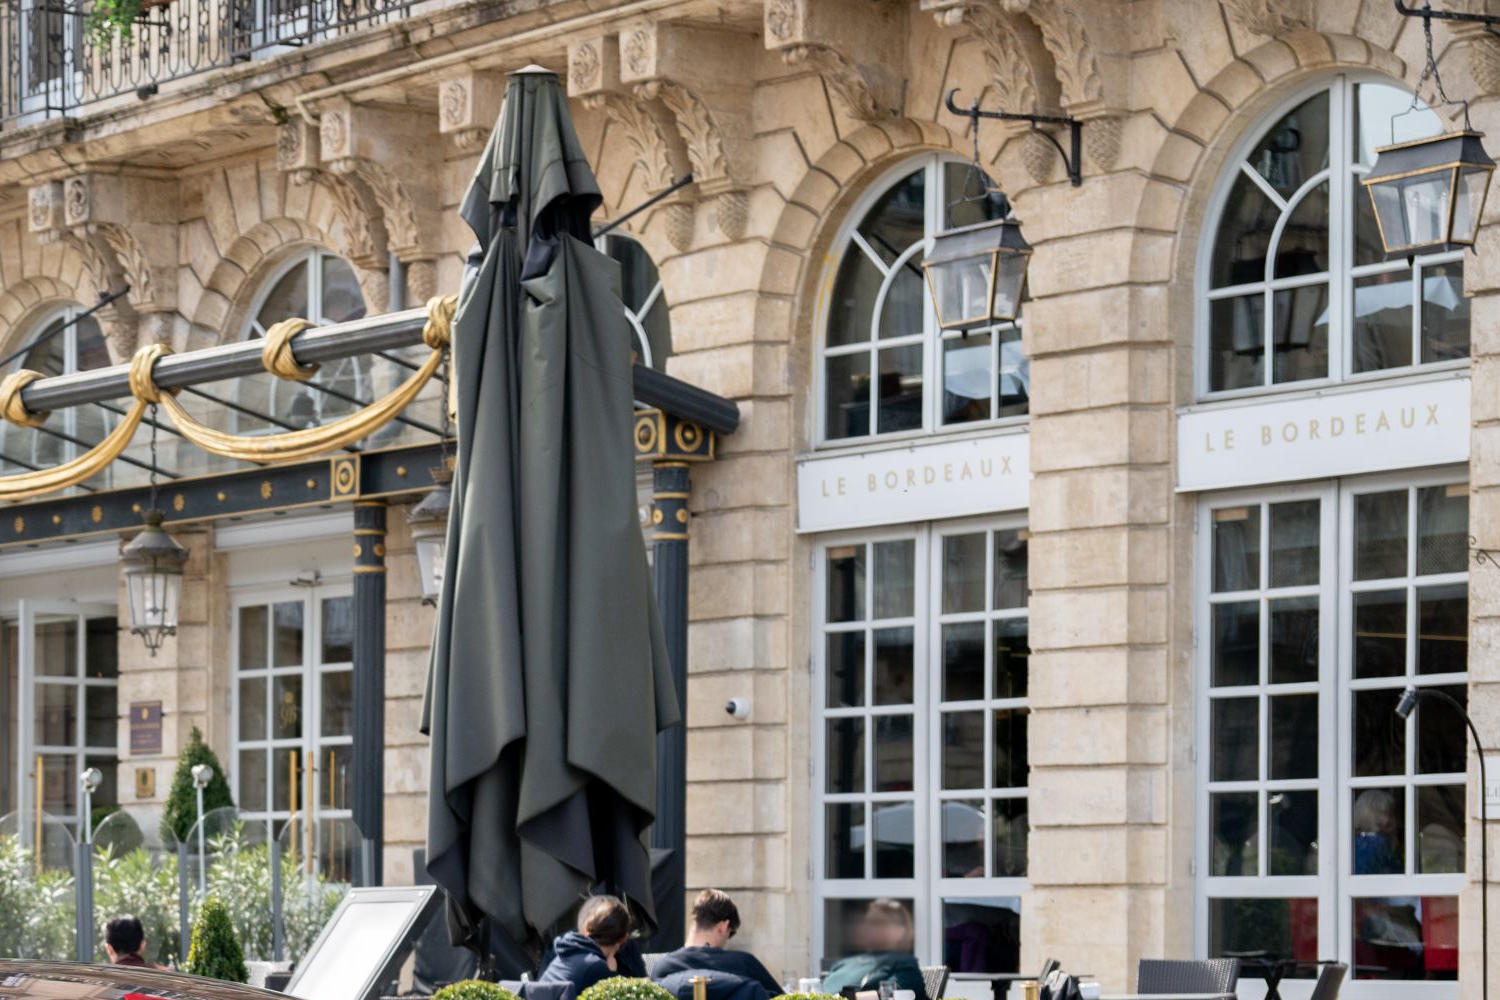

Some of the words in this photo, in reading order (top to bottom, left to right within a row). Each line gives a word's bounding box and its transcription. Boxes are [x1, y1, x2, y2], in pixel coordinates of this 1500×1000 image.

[1205, 429, 1235, 452] LE
[1260, 403, 1440, 446] BORDEAUX
[821, 476, 847, 498] LE
[867, 455, 1012, 492] BORDEAUX
